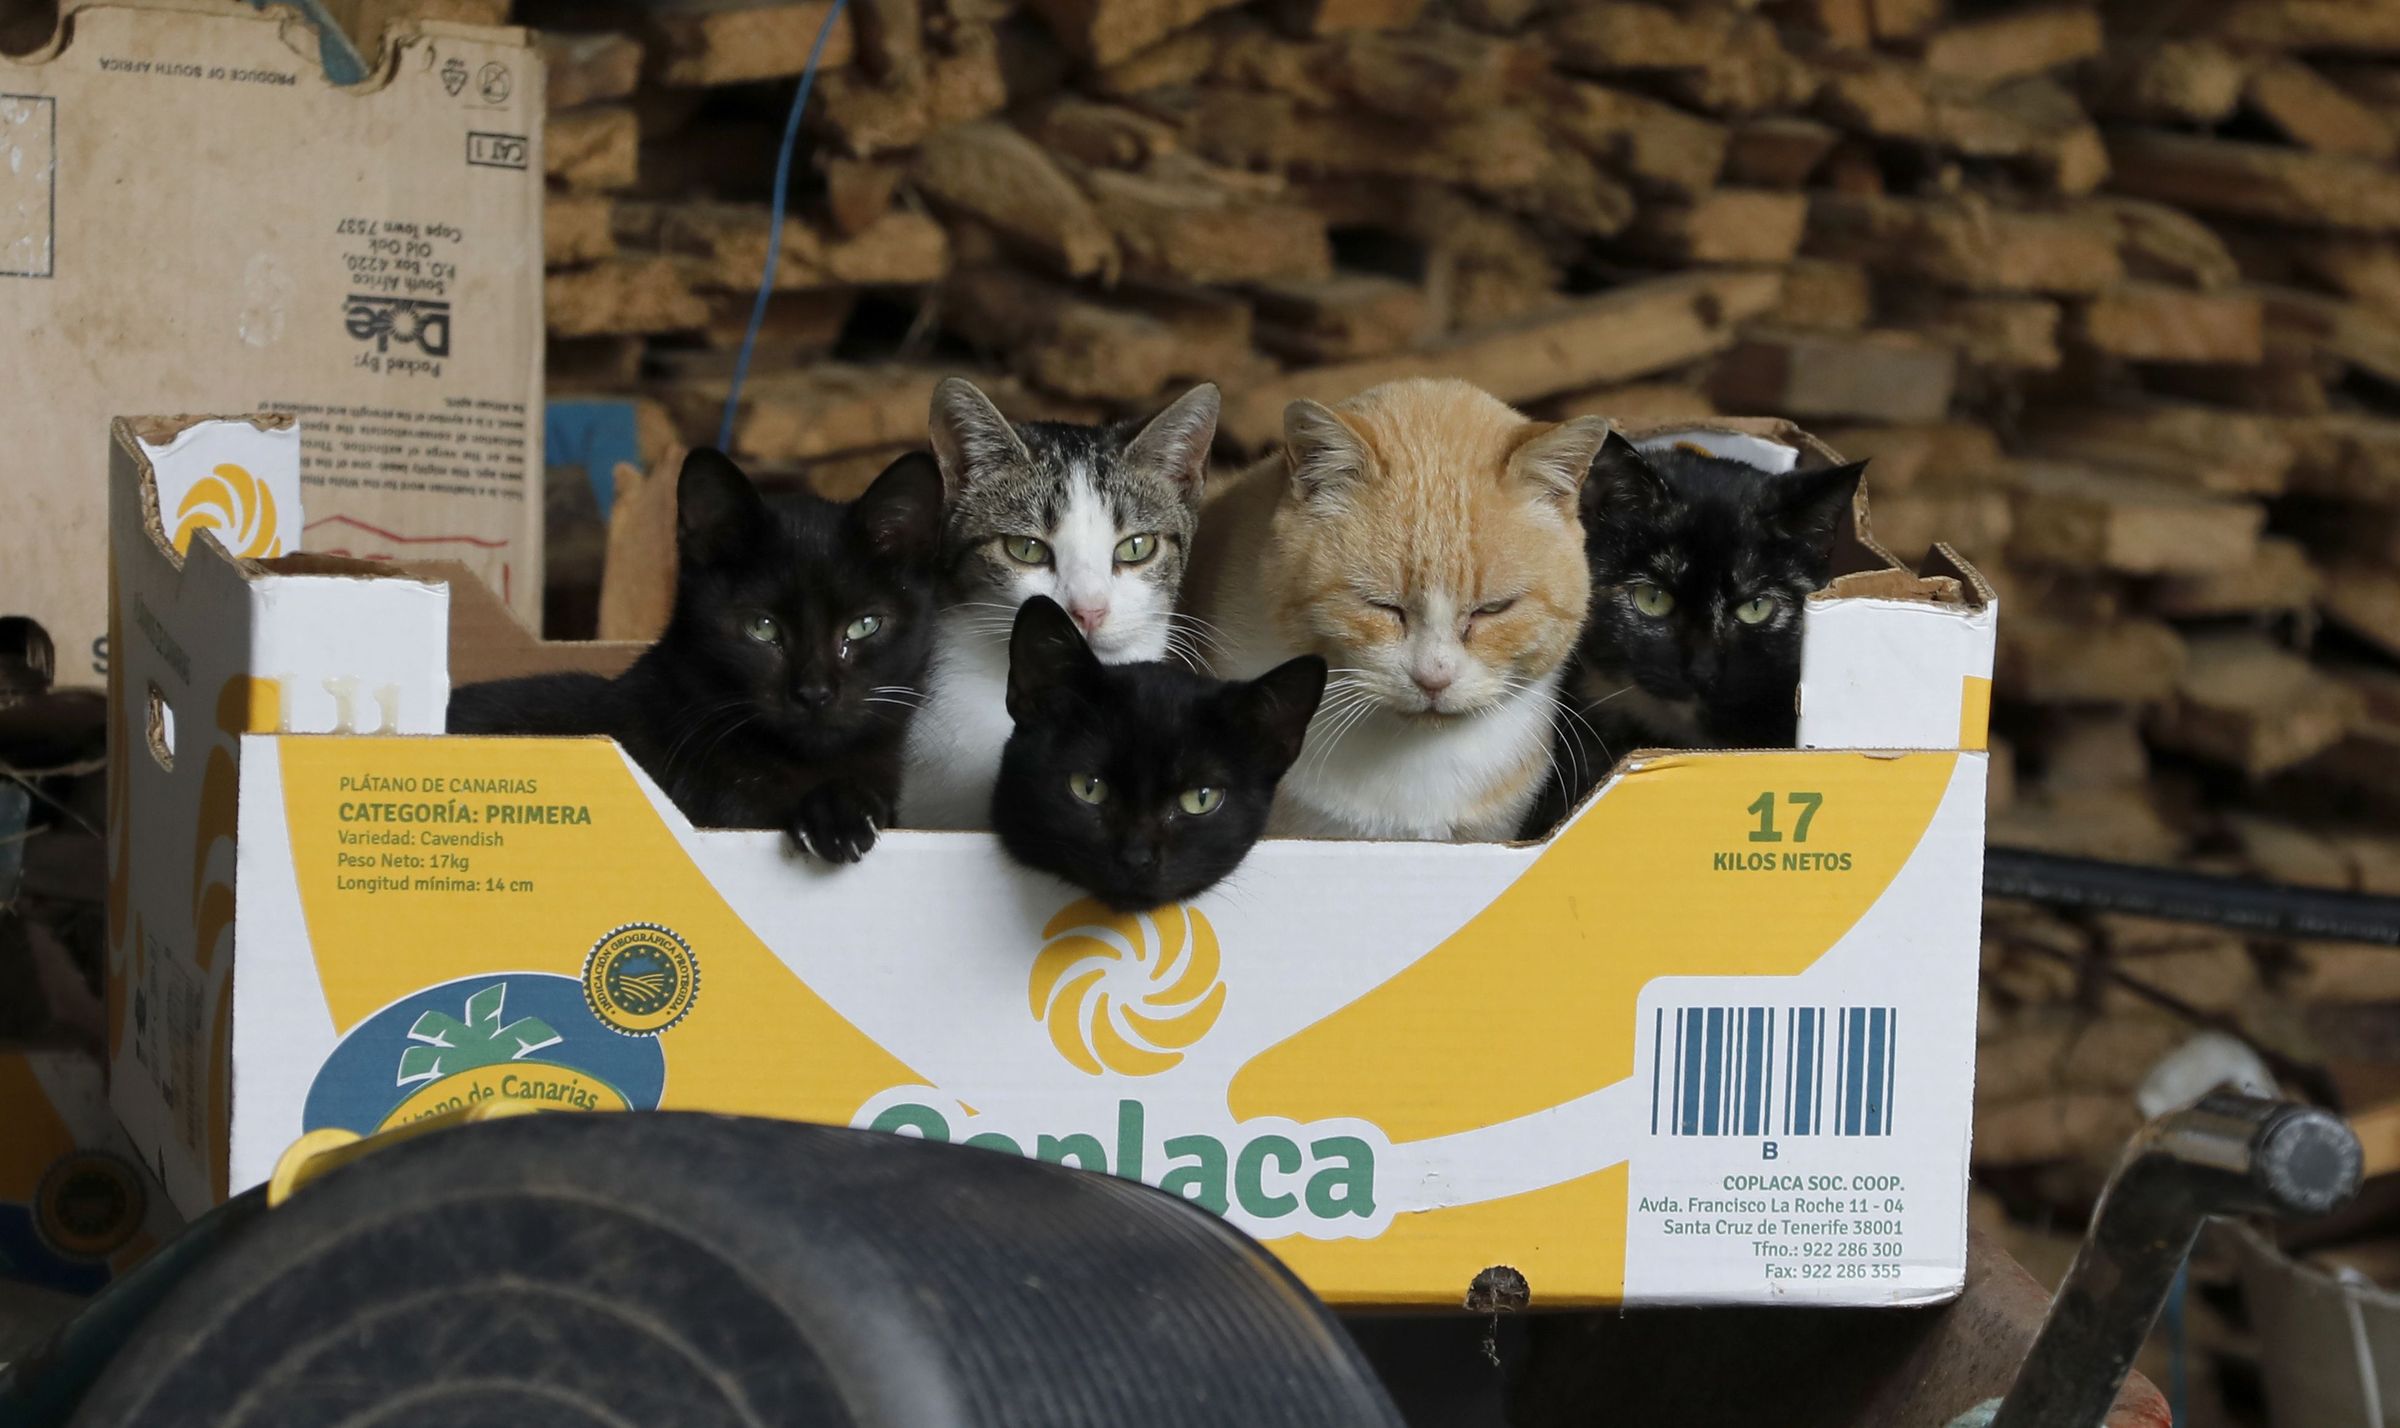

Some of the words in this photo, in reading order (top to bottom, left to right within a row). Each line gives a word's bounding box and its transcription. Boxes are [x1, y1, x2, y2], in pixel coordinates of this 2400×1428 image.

[99, 57, 152, 74] AFRICA
[156, 63, 202, 78] SOUTH
[207, 68, 225, 80] OF
[230, 68, 296, 86] PRODUCE
[491, 141, 523, 163] CAT
[336, 218, 378, 236] 7537
[383, 222, 419, 239] Town
[425, 222, 462, 244] Cape
[368, 239, 402, 256] Oak
[406, 242, 431, 258] Old
[342, 252, 389, 272] 4220,
[395, 259, 420, 275] Box
[427, 262, 455, 280] P.O.
[353, 274, 400, 291] Africa
[404, 277, 445, 295] South
[345, 304, 450, 357] Dole
[353, 352, 381, 373] By:
[386, 357, 441, 378] Packed
[327, 406, 346, 416] and
[350, 407, 393, 419] strength
[335, 424, 354, 435] the
[360, 427, 451, 440] conservationists
[455, 434, 467, 443] of
[340, 442, 402, 455] extinction.
[408, 448, 420, 458] of
[425, 446, 456, 459] verge
[462, 452, 480, 462] the
[315, 458, 333, 470] the
[335, 459, 348, 469] of
[351, 460, 372, 470] one
[412, 463, 447, 476] mighty
[328, 476, 359, 489] White
[362, 478, 380, 489] the
[383, 480, 398, 491] for
[400, 481, 425, 492] word
[339, 774, 417, 793] PLÁTANO
[422, 778, 444, 793] DE
[450, 778, 537, 794] CANARIAS
[338, 800, 479, 823] CATEGORÍA:
[486, 805, 592, 825] PRIMERA
[1747, 792, 1823, 843] 17
[338, 830, 415, 846] Variedad:
[420, 832, 504, 847] Cavendish
[337, 853, 376, 868] Peso
[381, 854, 425, 869] Neto:
[430, 854, 469, 872] 17kg
[1713, 852, 1776, 871] KILOS
[1782, 852, 1852, 871] NETOS
[337, 876, 409, 894] Longitud
[414, 877, 481, 892] mínima:
[486, 878, 505, 892] 14
[510, 881, 533, 892] cm
[593, 949, 613, 1012] INDICACIÓN
[610, 932, 678, 955] GEOGRÁFICA
[674, 952, 690, 1012] PROTEGIDA
[468, 1081, 496, 1104] de
[501, 1075, 599, 1112] Canarias
[868, 1099, 1377, 1219] laca
[1762, 1141, 1779, 1160] B
[1723, 1175, 1804, 1192] COPLACA
[1808, 1175, 1848, 1192] SOC.
[1852, 1175, 1905, 1192] COOP.
[1638, 1198, 1683, 1214] Avda.
[1688, 1197, 1766, 1214] Francisco
[1770, 1199, 1790, 1213] La
[1795, 1197, 1845, 1213] Roche
[1849, 1199, 1868, 1213] 11
[1884, 1198, 1905, 1213] 04
[1663, 1219, 1711, 1236] Santa
[1715, 1219, 1753, 1235] Cruz
[1757, 1219, 1777, 1235] de
[1782, 1219, 1849, 1236] Tenerife
[1852, 1220, 1903, 1235] 38001
[1752, 1242, 1799, 1258] Tfno.:
[1803, 1242, 1833, 1257] 922
[1837, 1242, 1868, 1257] 286
[1871, 1242, 1903, 1257] 300
[1765, 1264, 1798, 1279] Fax:
[1802, 1264, 1832, 1279] 922
[1837, 1264, 1867, 1279] 286
[1871, 1264, 1901, 1279] 355
